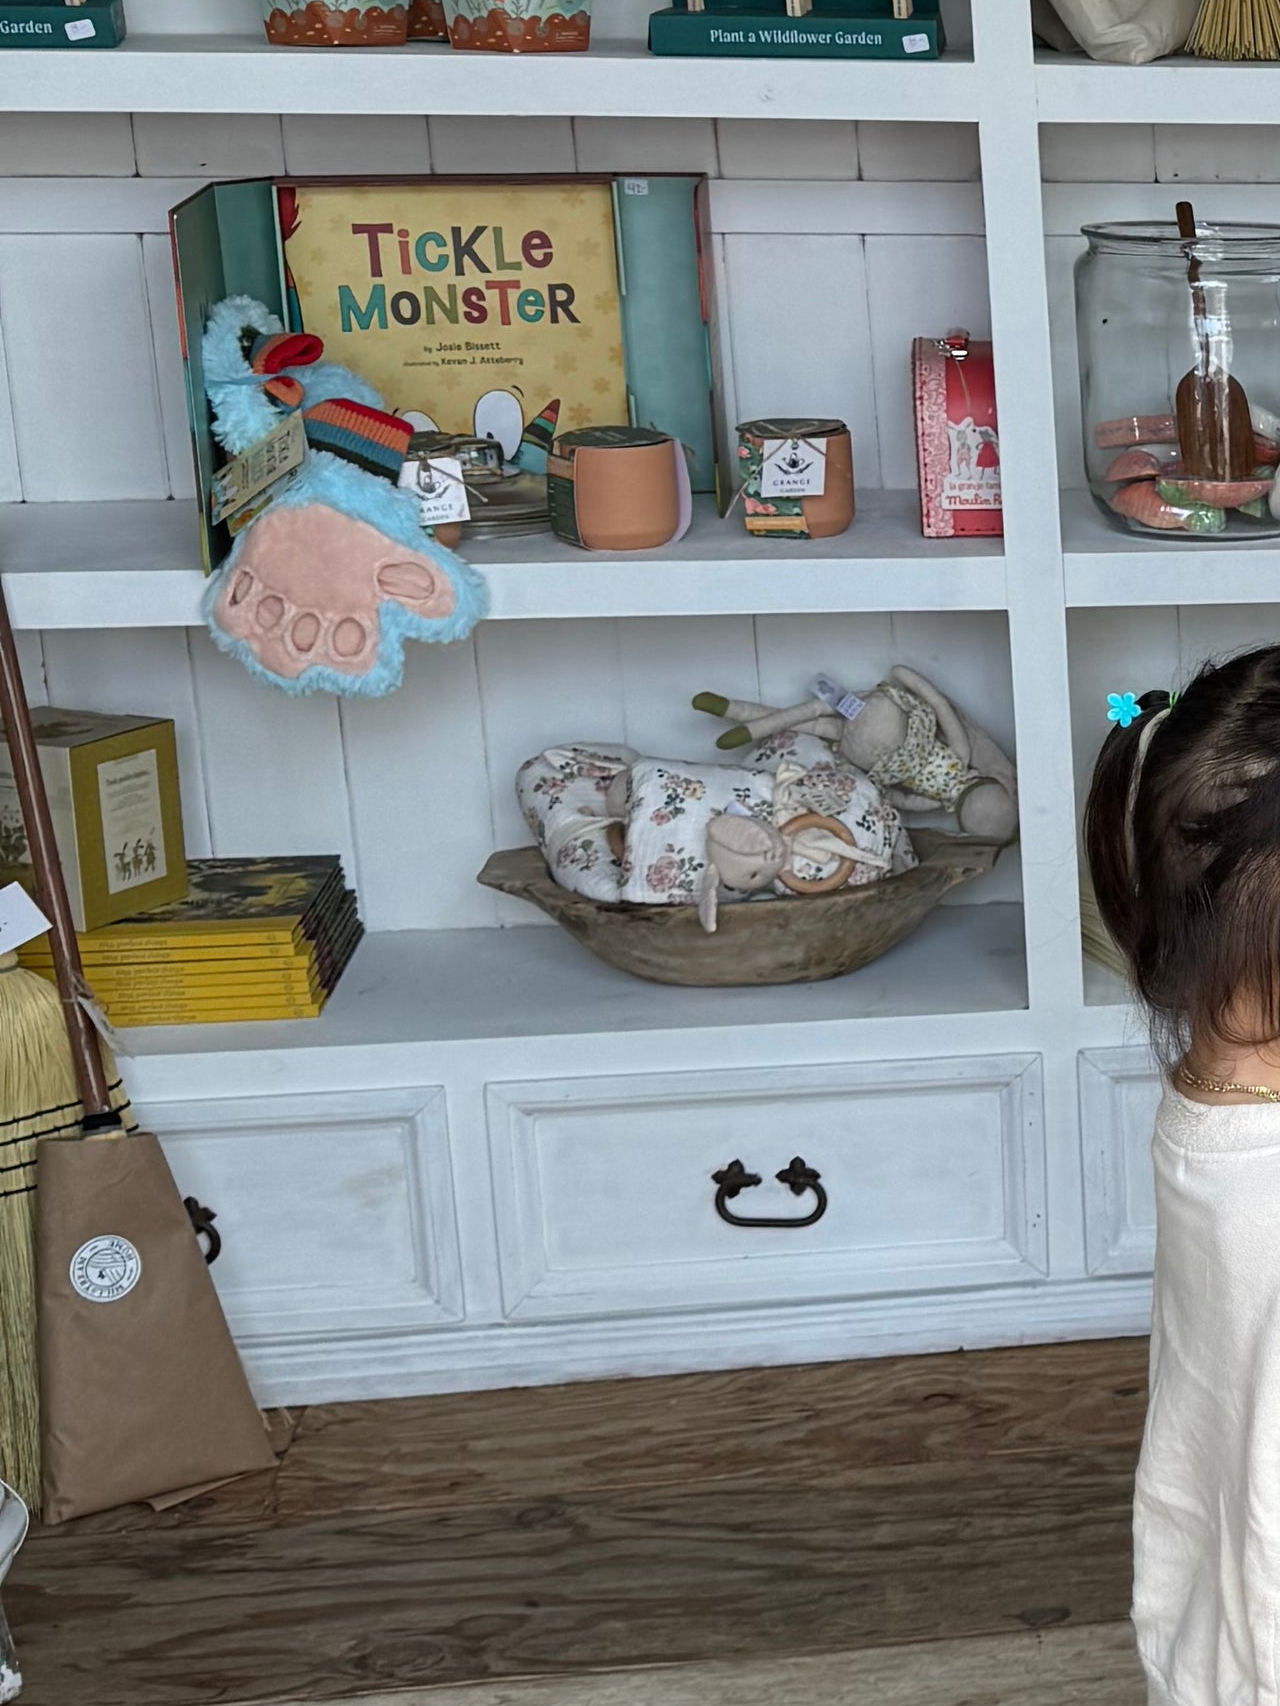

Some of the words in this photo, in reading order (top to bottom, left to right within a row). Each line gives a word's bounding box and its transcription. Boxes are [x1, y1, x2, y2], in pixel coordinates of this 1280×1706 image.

[0, 20, 53, 34] Garden
[709, 28, 744, 43] Plant
[747, 34, 756, 43] a
[758, 29, 832, 44] Wildflower
[834, 31, 882, 45] Garden
[435, 341, 462, 353] Josie
[464, 341, 501, 352] Bissett
[772, 478, 811, 487] GRANGE
[956, 483, 985, 494] grange
[946, 495, 992, 506] Moulin
[419, 504, 454, 514] RANGE
